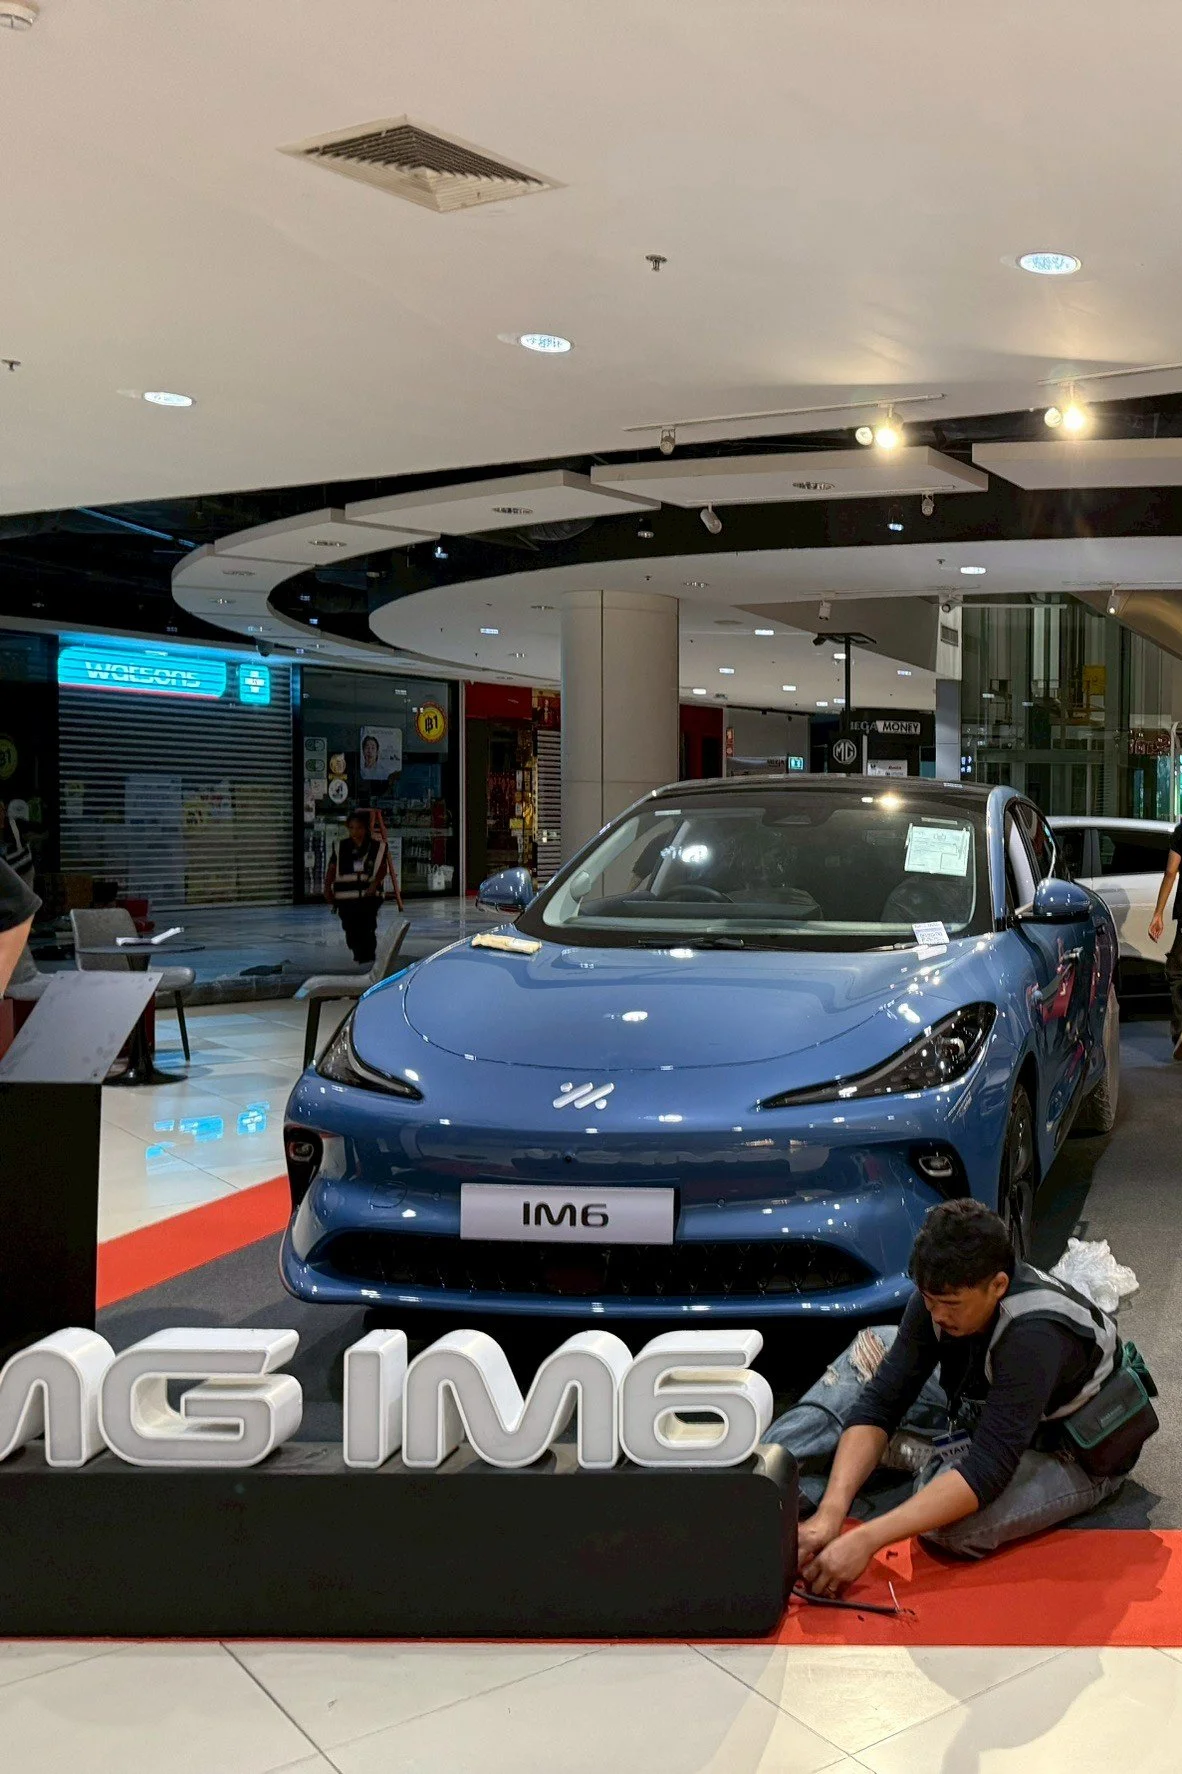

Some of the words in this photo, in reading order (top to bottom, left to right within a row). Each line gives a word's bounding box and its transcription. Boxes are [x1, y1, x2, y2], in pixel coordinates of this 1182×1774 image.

[85, 661, 200, 688] watsons
[850, 720, 877, 733] EGA
[882, 721, 919, 733] MONEY
[834, 740, 856, 763] MG
[522, 1201, 610, 1228] IM6
[343, 1328, 775, 1470] IM6
